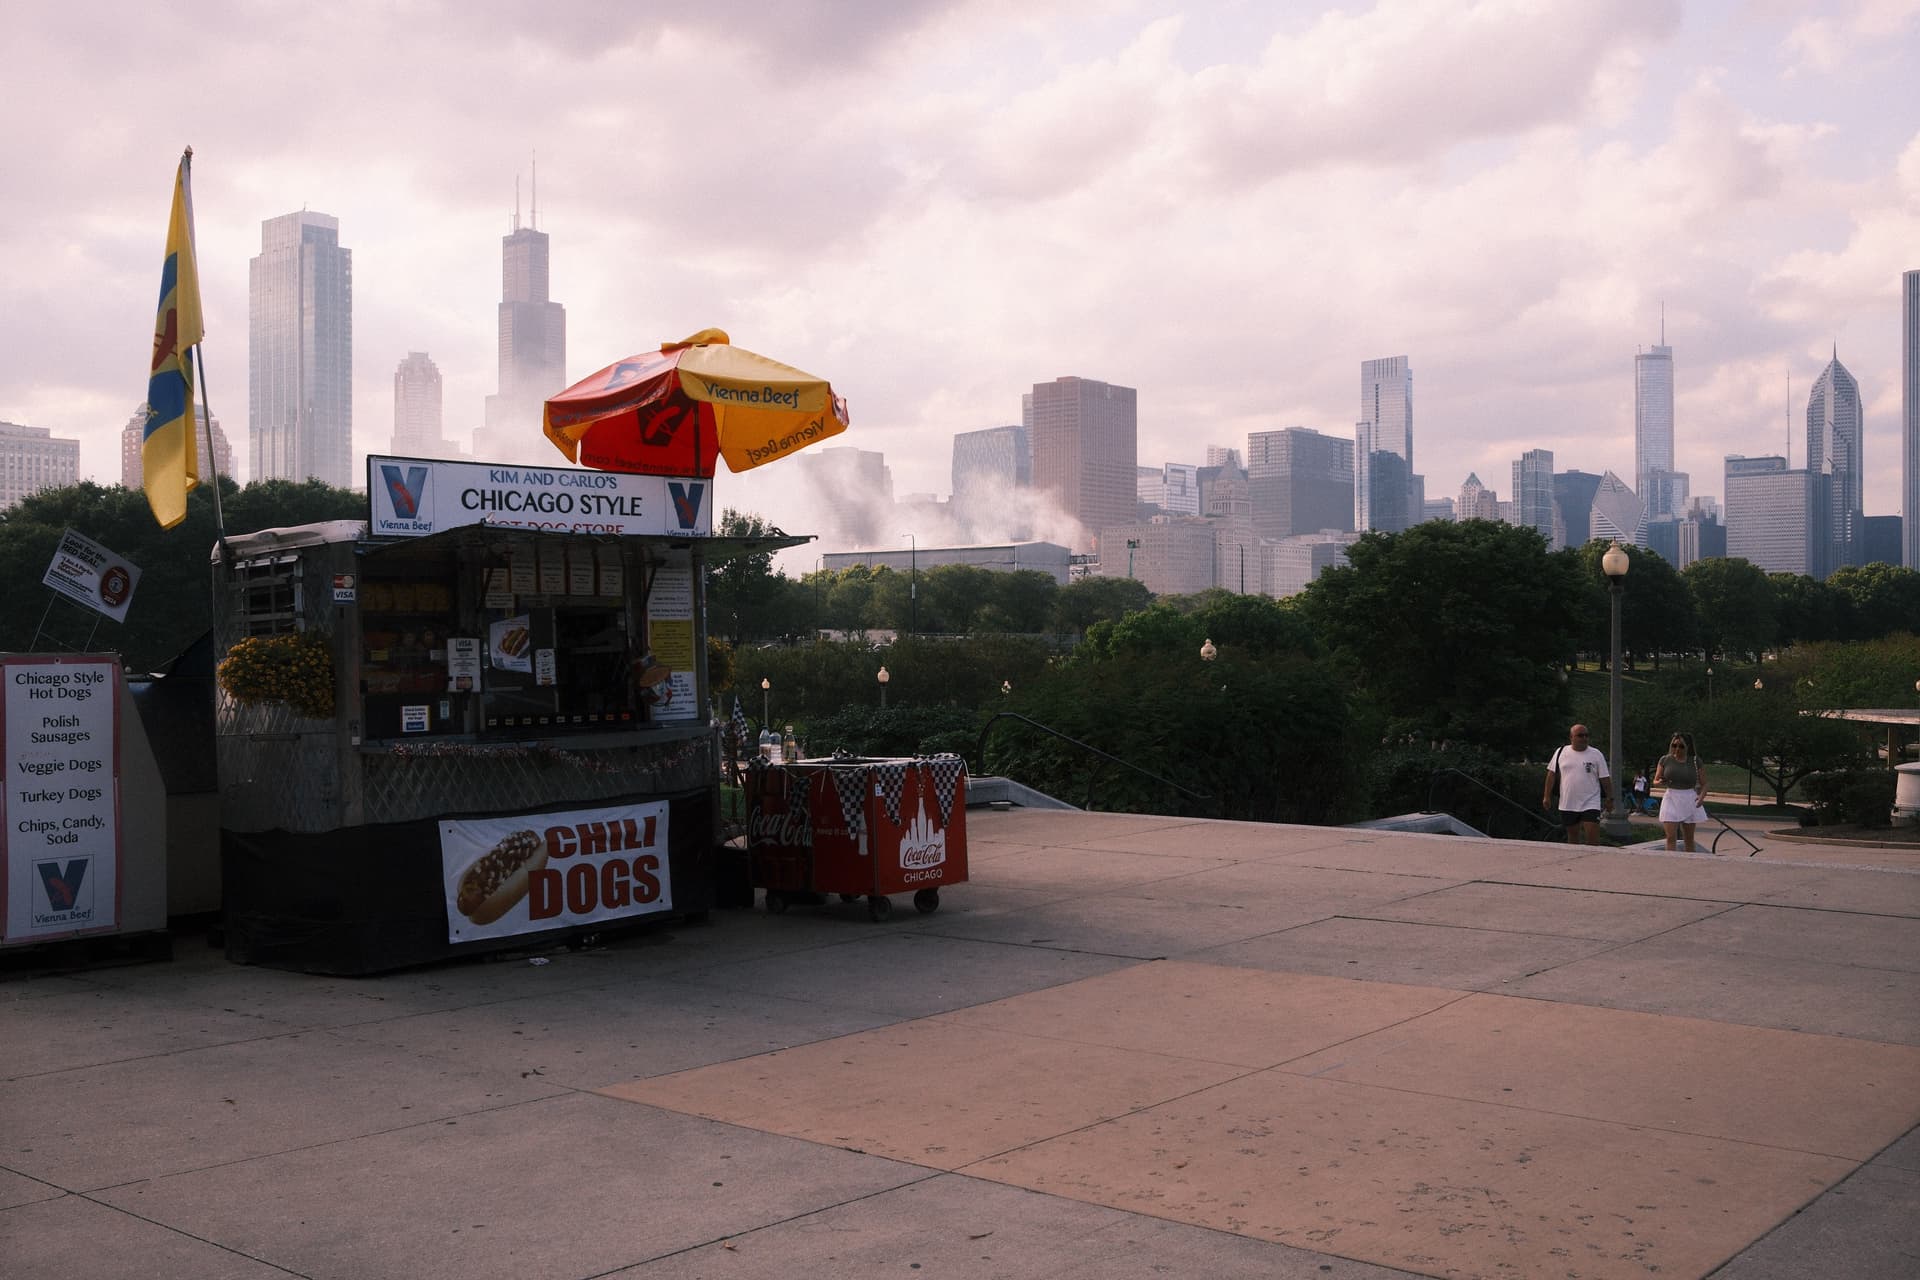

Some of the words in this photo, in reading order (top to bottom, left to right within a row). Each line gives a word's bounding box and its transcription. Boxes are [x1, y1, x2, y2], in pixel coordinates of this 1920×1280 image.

[703, 381, 759, 403] Vienna
[763, 387, 799, 409] Beef
[490, 469, 520, 485] KIM
[523, 471, 554, 487] AND
[558, 473, 618, 490] CARLO'S
[461, 488, 574, 514] CHICAGO
[580, 494, 643, 517] STYLE
[380, 520, 409, 530] Vienna
[413, 520, 432, 532] Beef
[62, 543, 78, 556] RED
[336, 591, 353, 599] VISA
[15, 672, 70, 688] Chicago
[73, 671, 104, 686] Style
[29, 687, 54, 699] Hot
[57, 686, 92, 701] Dogs
[42, 715, 80, 728] Polish
[31, 730, 90, 745] Sausages
[19, 760, 65, 776] Veggie
[69, 758, 102, 773] Dogs
[20, 790, 65, 804] Turkey
[69, 787, 102, 802] Dogs
[19, 819, 60, 835] Chips,
[62, 815, 105, 831] Candy,
[47, 832, 79, 845] Soda
[544, 815, 658, 859] CHILI
[903, 868, 943, 884] CHICAGO
[528, 854, 661, 921] DOGS
[34, 913, 67, 924] Vienna
[69, 909, 92, 922] Beef
